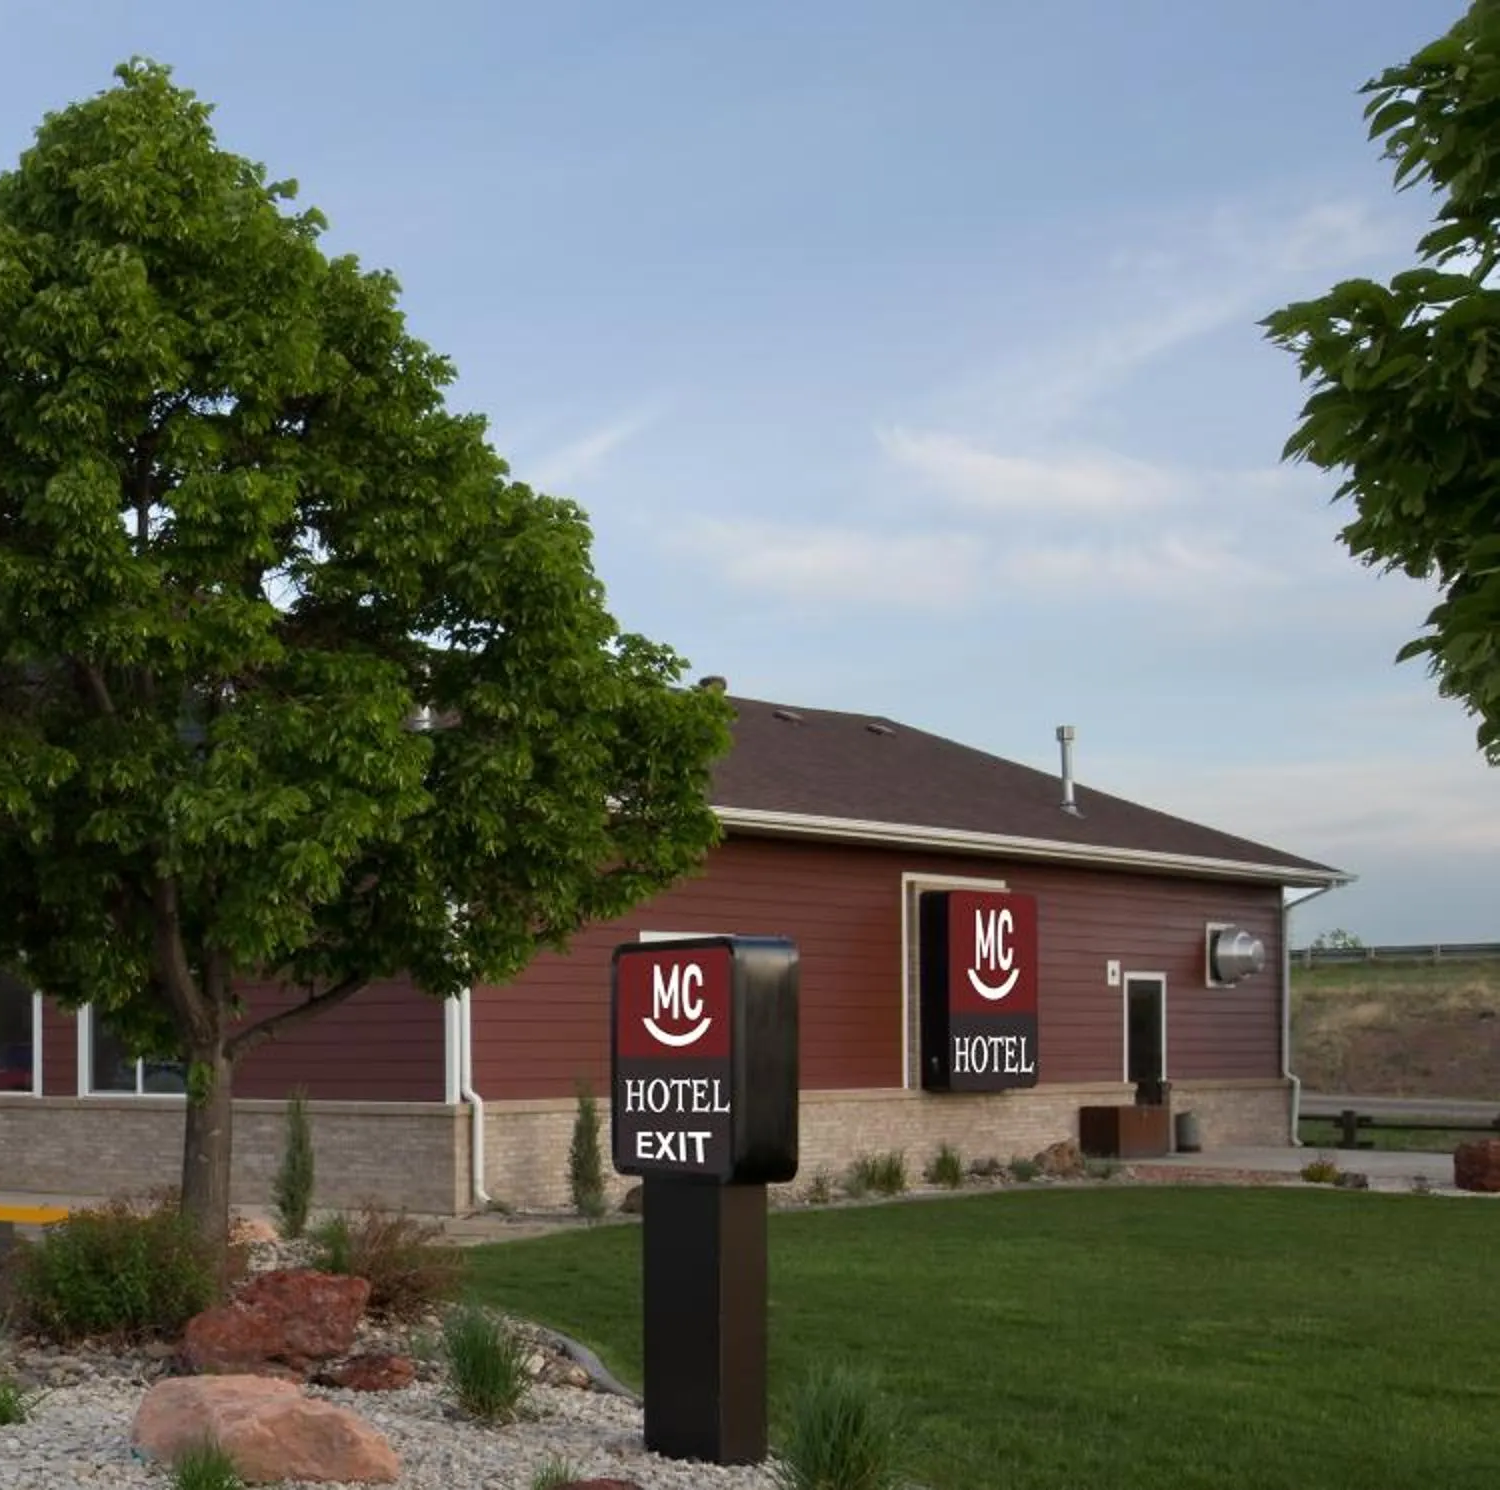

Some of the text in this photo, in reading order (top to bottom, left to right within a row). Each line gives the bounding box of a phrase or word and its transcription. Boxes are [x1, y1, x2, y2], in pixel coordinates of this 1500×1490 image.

[975, 909, 1014, 970] MC
[653, 963, 704, 1020] MC
[954, 1035, 1035, 1074] HOTEL
[625, 1078, 731, 1113] HOTEL
[636, 1131, 712, 1163] EXIT
